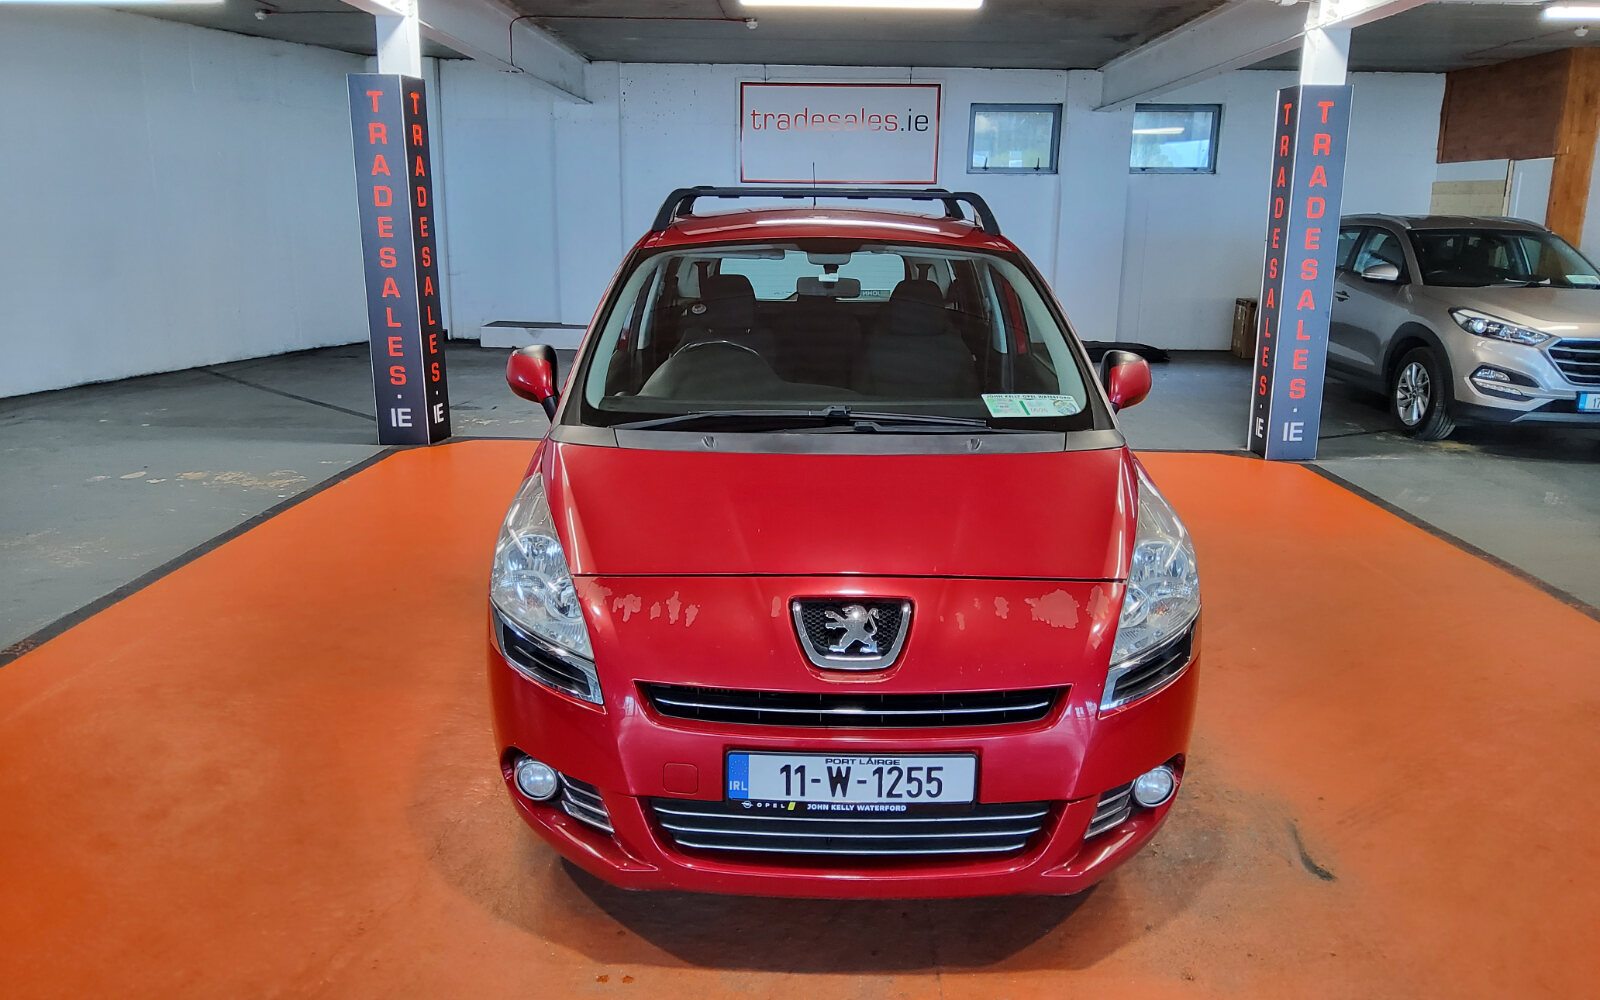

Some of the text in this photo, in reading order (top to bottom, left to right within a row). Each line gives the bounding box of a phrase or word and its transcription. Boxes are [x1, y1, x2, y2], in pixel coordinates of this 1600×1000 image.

[750, 107, 929, 132] tradesales.ie
[729, 780, 748, 791] IRL
[780, 764, 944, 799] 11-W-1255
[807, 803, 907, 812] JOHN KELLY WATERFORD
